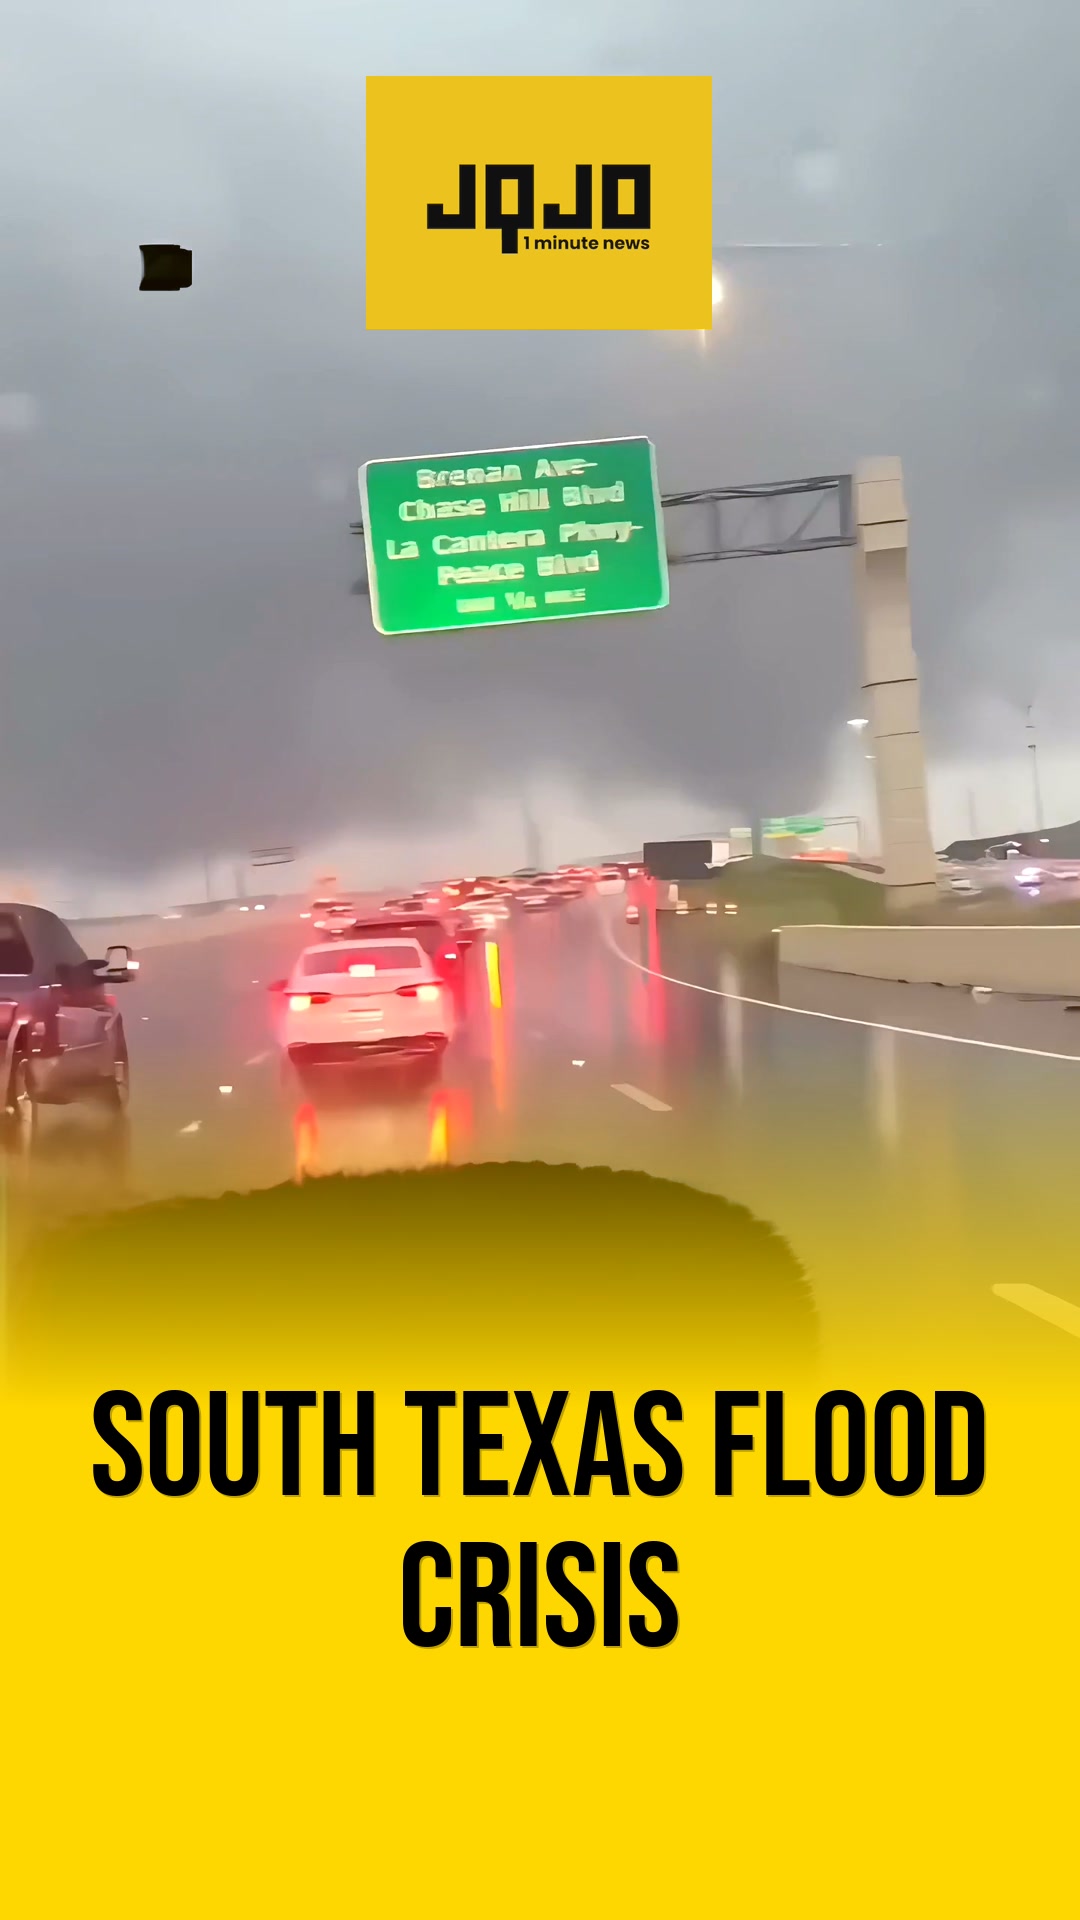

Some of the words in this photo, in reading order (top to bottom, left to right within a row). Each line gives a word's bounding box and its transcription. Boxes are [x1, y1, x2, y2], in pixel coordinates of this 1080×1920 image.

[398, 499, 487, 522] Chase
[498, 487, 551, 513] Hill
[386, 539, 420, 560] La
[431, 529, 546, 555] Cantera
